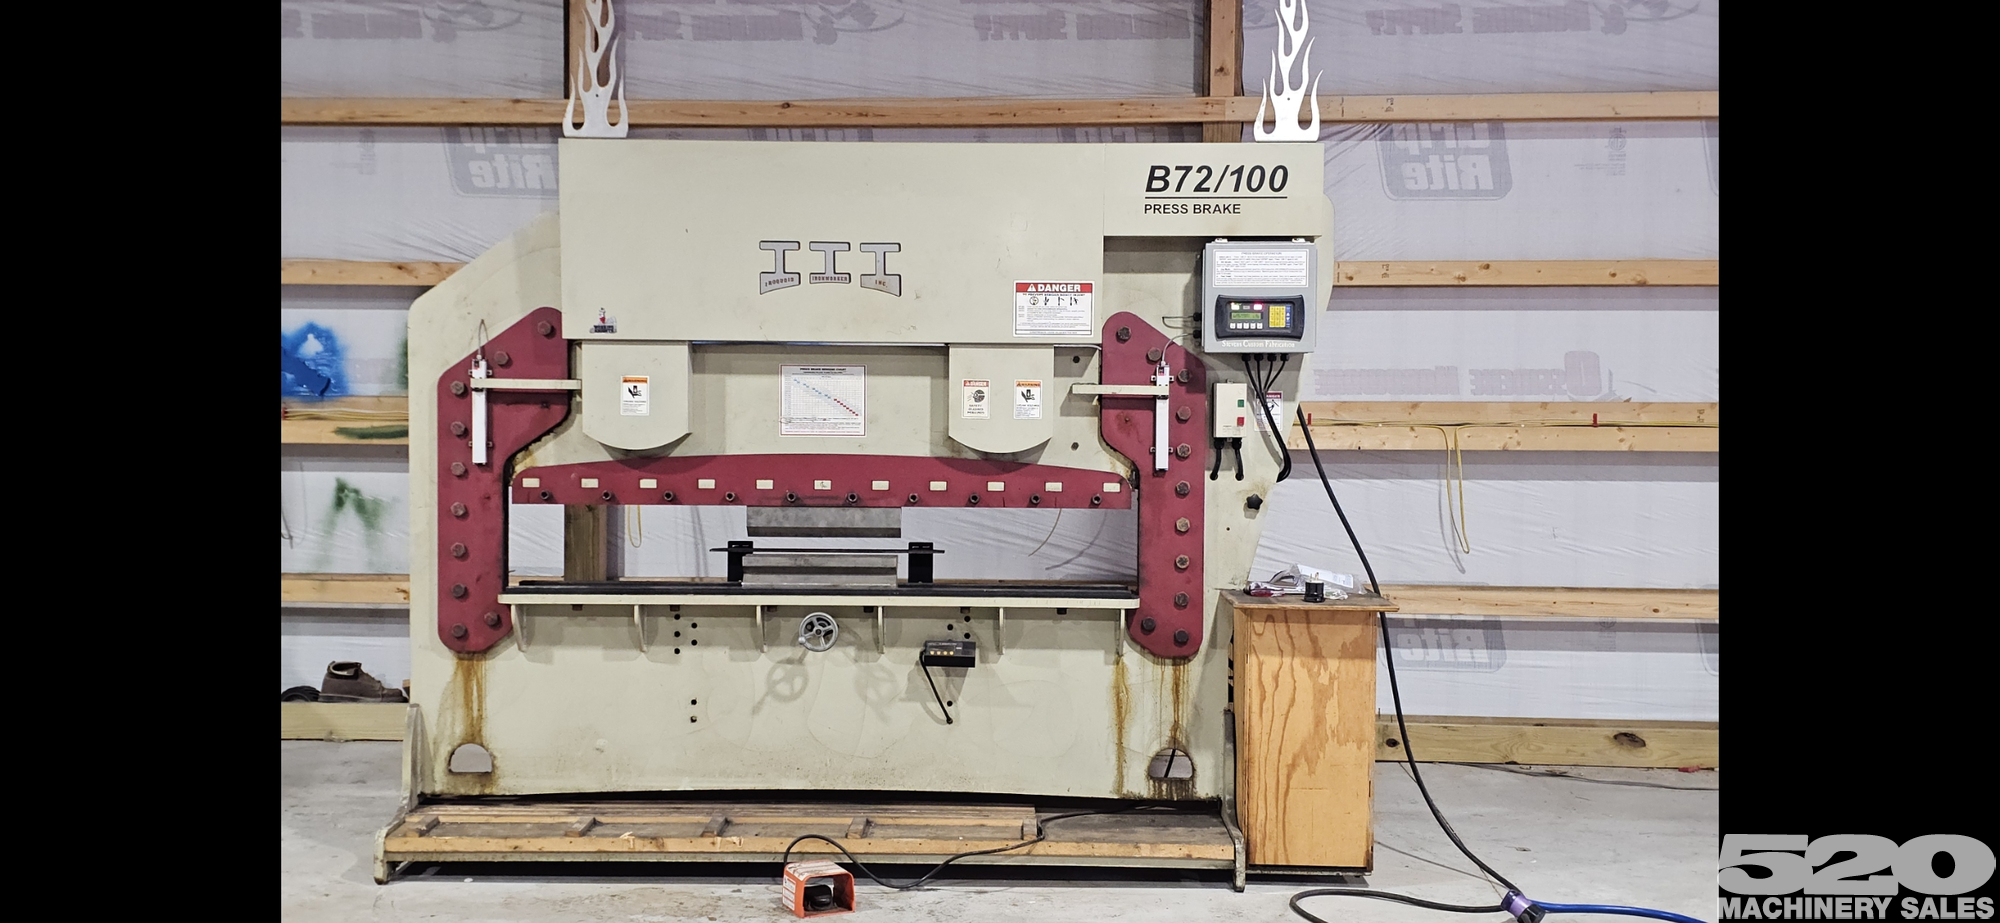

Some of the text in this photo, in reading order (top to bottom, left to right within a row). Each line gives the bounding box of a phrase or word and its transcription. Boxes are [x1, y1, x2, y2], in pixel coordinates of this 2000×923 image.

[1145, 165, 1289, 193] B72/100
[1144, 203, 1241, 215] PRESS BRAKE
[1037, 284, 1081, 292] DANGER
